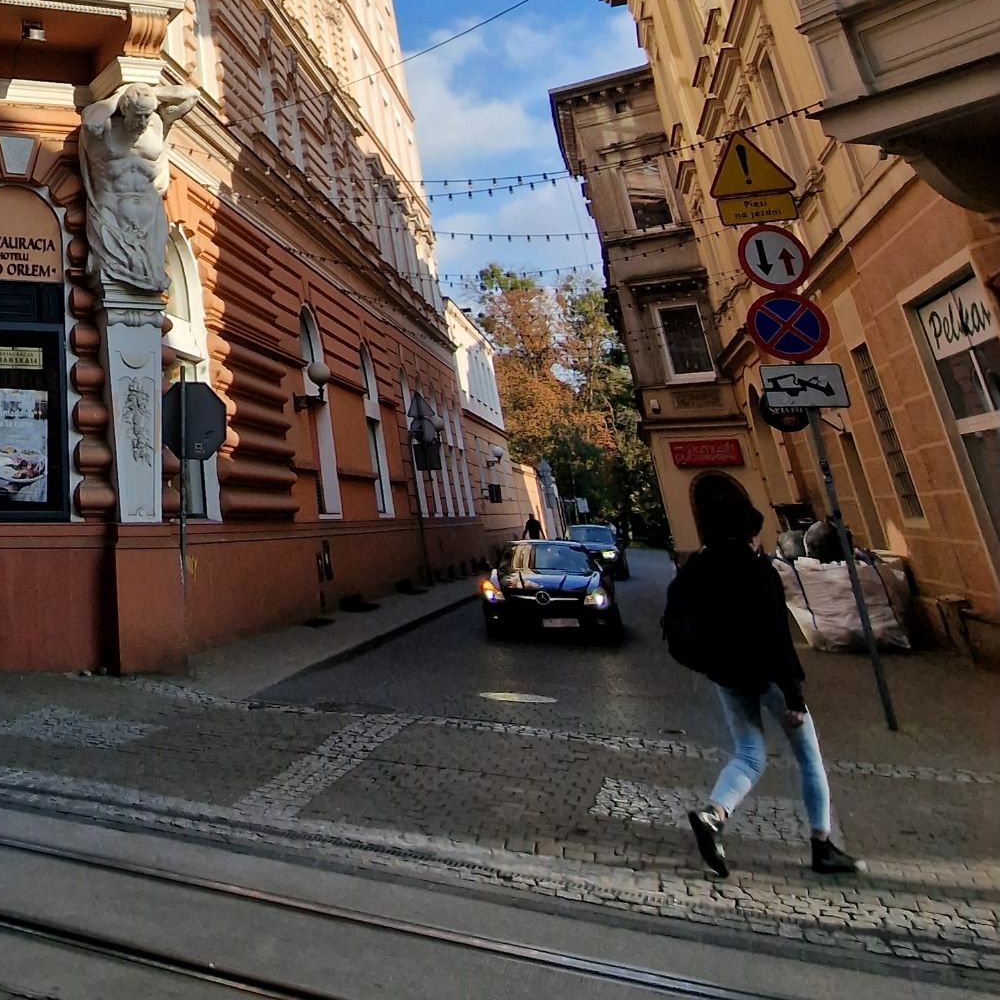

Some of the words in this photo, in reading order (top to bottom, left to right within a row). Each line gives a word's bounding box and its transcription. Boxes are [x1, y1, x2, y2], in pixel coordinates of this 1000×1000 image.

[744, 199, 768, 208] Piesi
[751, 208, 782, 219] jezdni
[7, 263, 51, 277] ORŁEM
